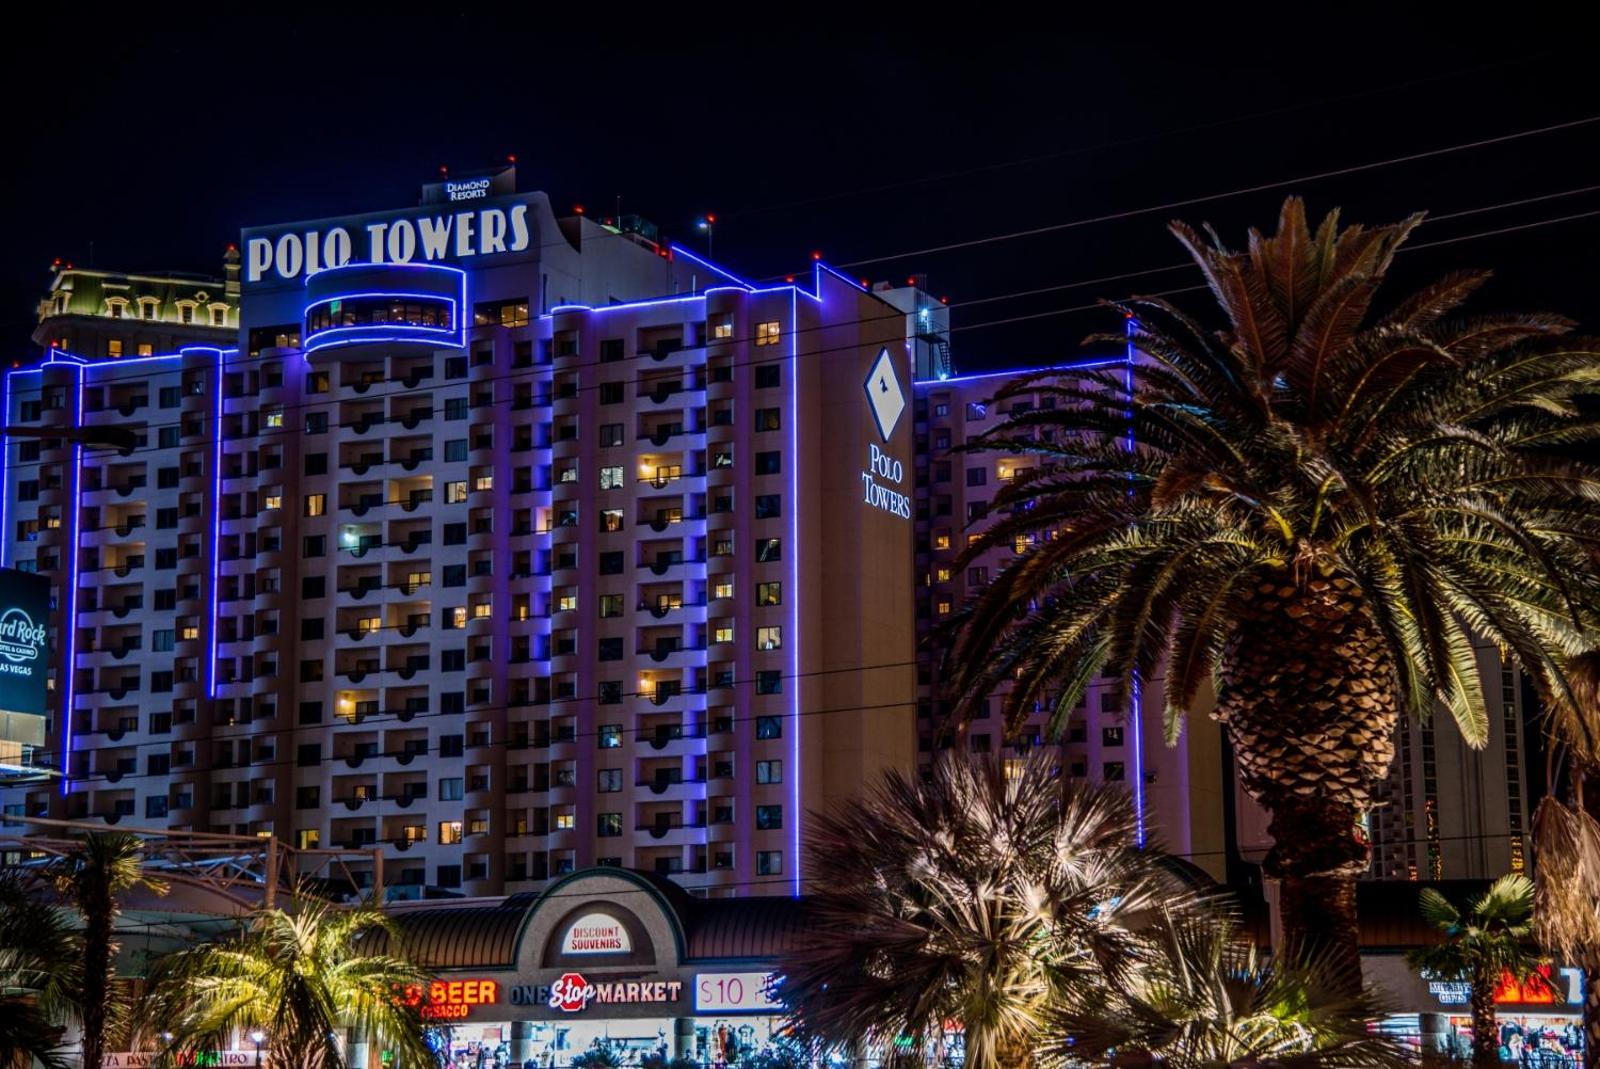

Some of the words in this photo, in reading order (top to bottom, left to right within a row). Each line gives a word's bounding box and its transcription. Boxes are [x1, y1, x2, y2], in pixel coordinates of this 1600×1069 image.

[447, 180, 490, 193] DIAMOND
[451, 189, 487, 201] RESORTS
[248, 228, 352, 282] POLO
[367, 205, 530, 265] TOWERS
[870, 444, 903, 484] POLO
[862, 472, 911, 520] TOWERS
[0, 619, 18, 637] rd
[17, 621, 46, 646] Rock
[0, 663, 9, 672] AS
[9, 664, 32, 676] VEGAS
[571, 937, 622, 950] SOUVENIRS
[573, 926, 620, 939] DISCOUNT
[430, 980, 496, 1004] BEER
[509, 985, 550, 1005] ONE
[549, 977, 596, 1009] Stop
[596, 982, 682, 1003] MARKET
